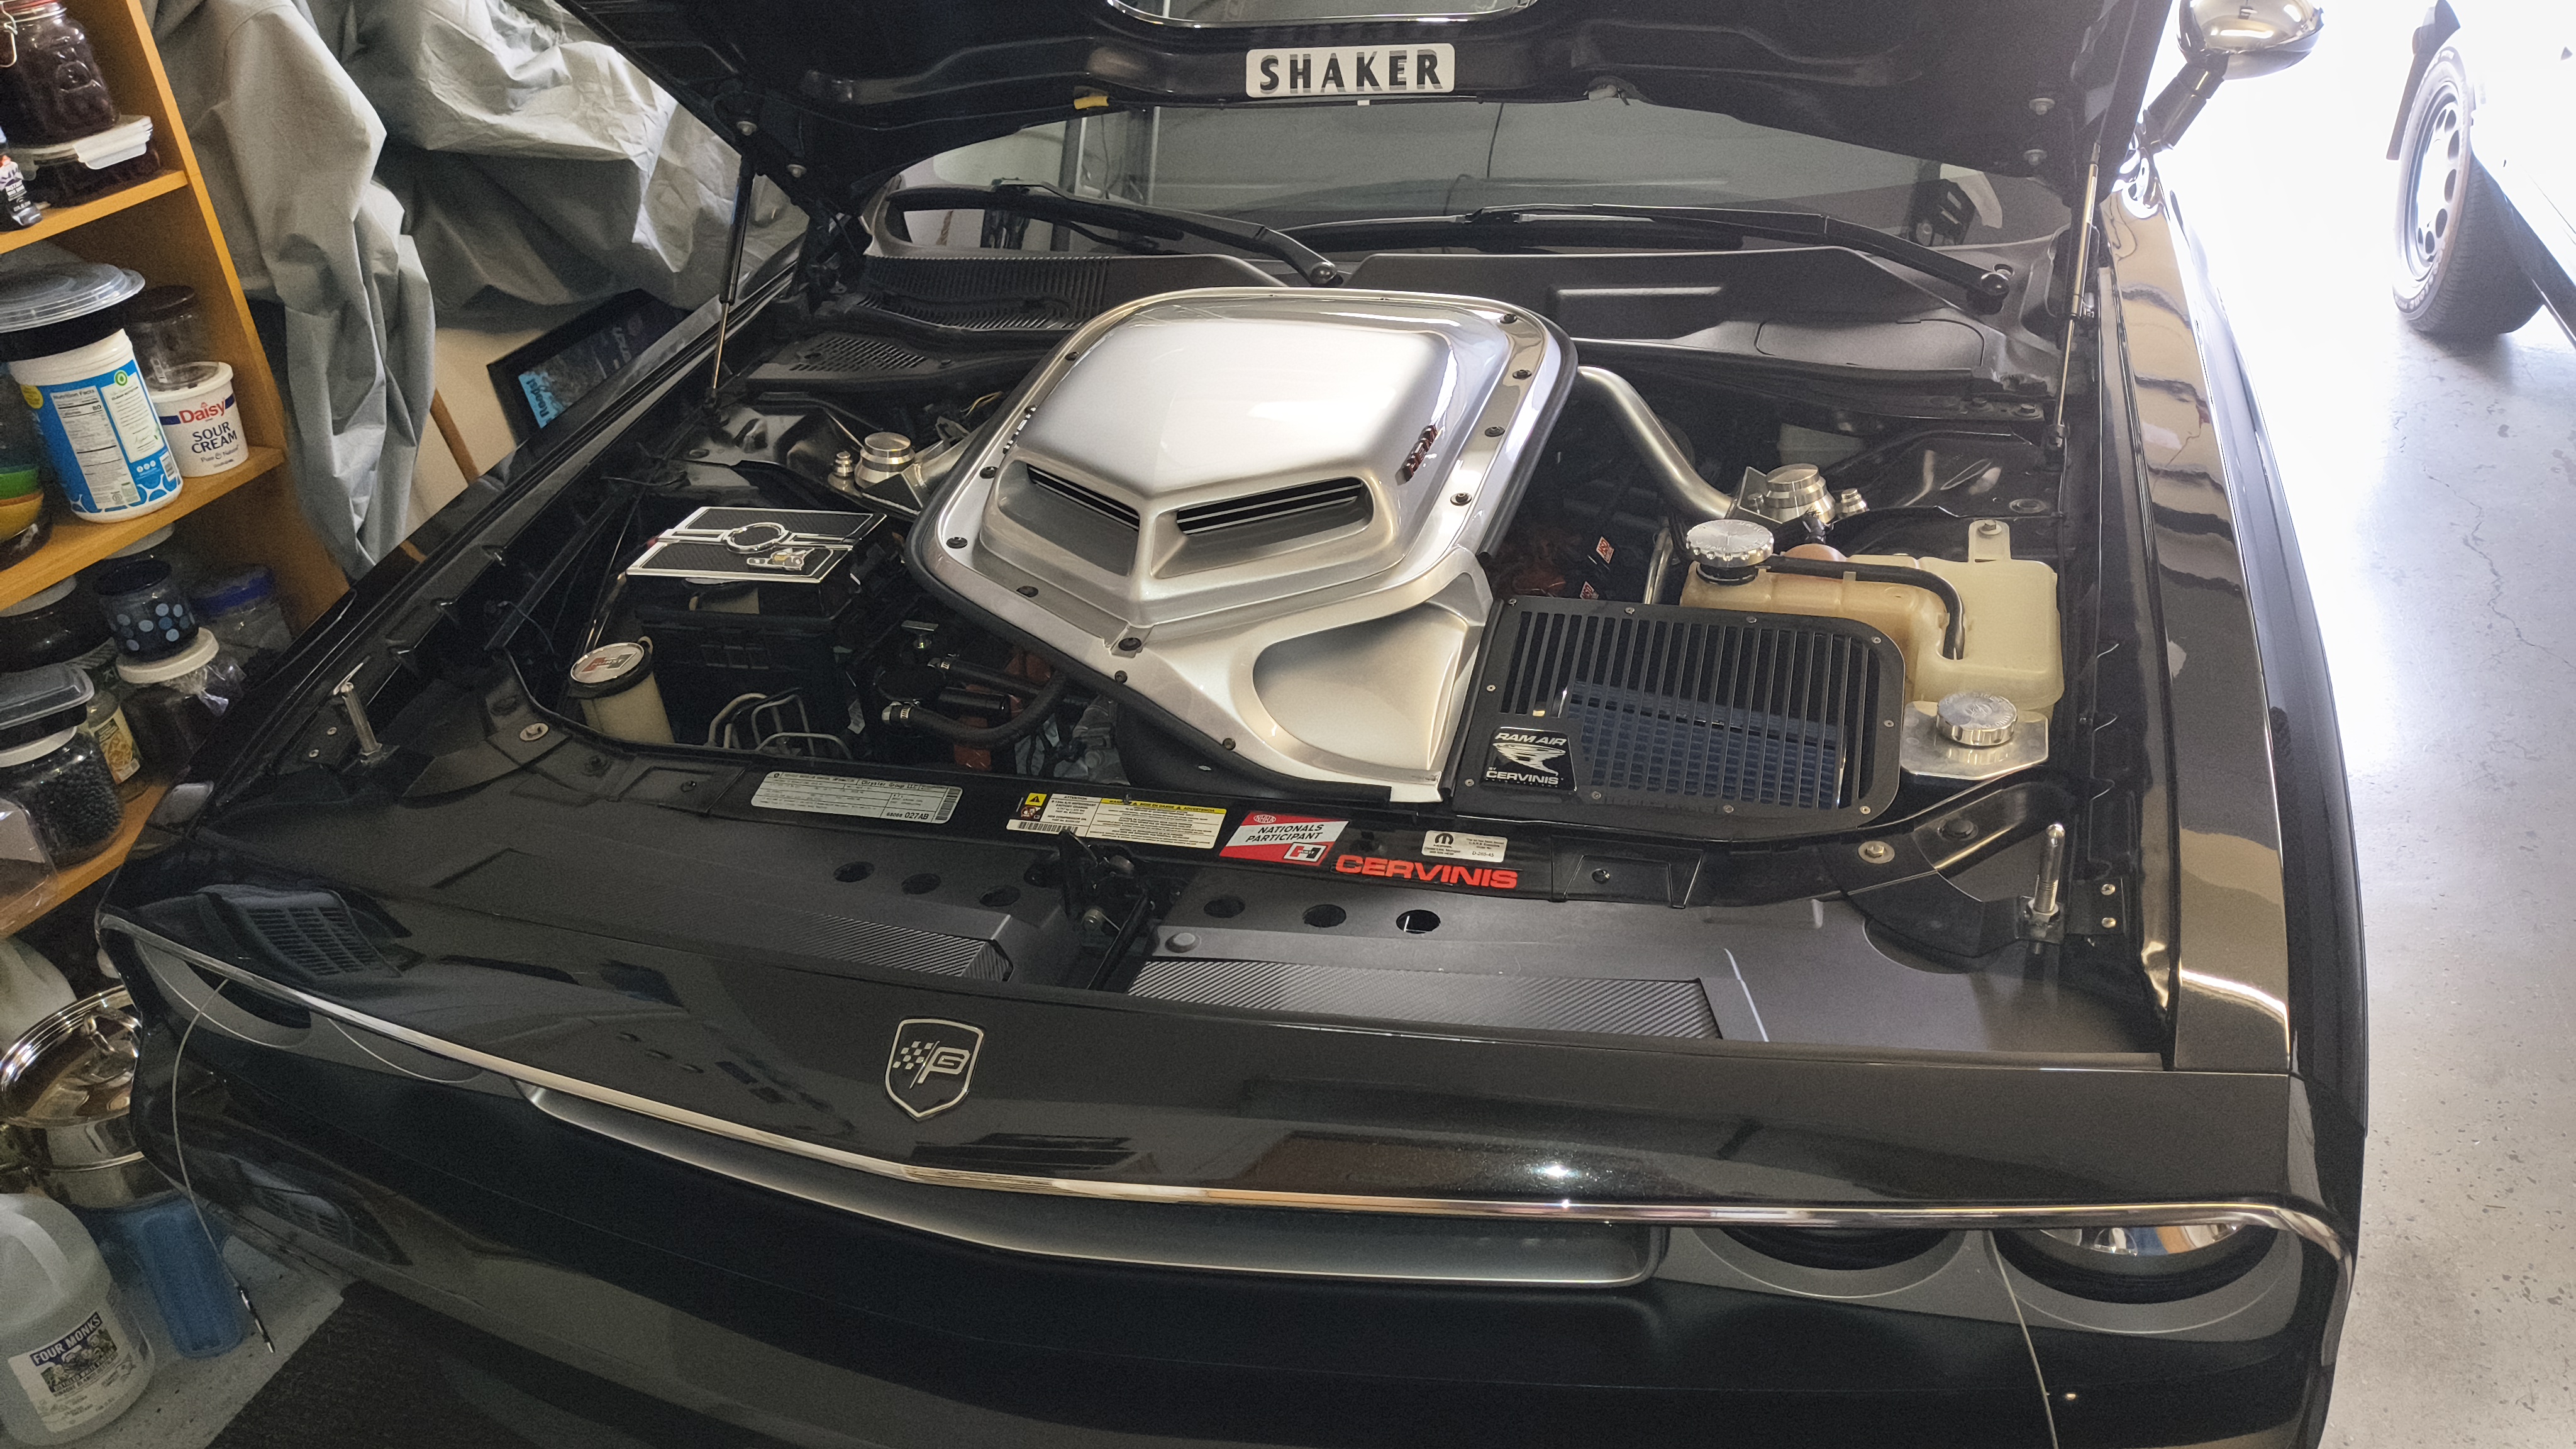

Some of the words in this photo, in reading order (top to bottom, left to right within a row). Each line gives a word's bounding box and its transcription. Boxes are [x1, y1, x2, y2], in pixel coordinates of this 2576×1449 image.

[1260, 49, 1443, 94] SHAKER
[179, 401, 225, 423] Daisy
[192, 422, 230, 442] SOUR
[192, 430, 237, 453] CREAM
[1495, 733, 1536, 743] RAM
[1536, 737, 1567, 745] AIR
[1486, 770, 1559, 784] CERVINIS
[905, 812, 929, 820] 027AB
[1245, 832, 1323, 842] PARTICIPANT
[1258, 824, 1324, 834] NATIONALS
[1335, 854, 1518, 889] CERVINIS
[33, 1343, 66, 1365] FOUR
[65, 1314, 101, 1349] MONKS
